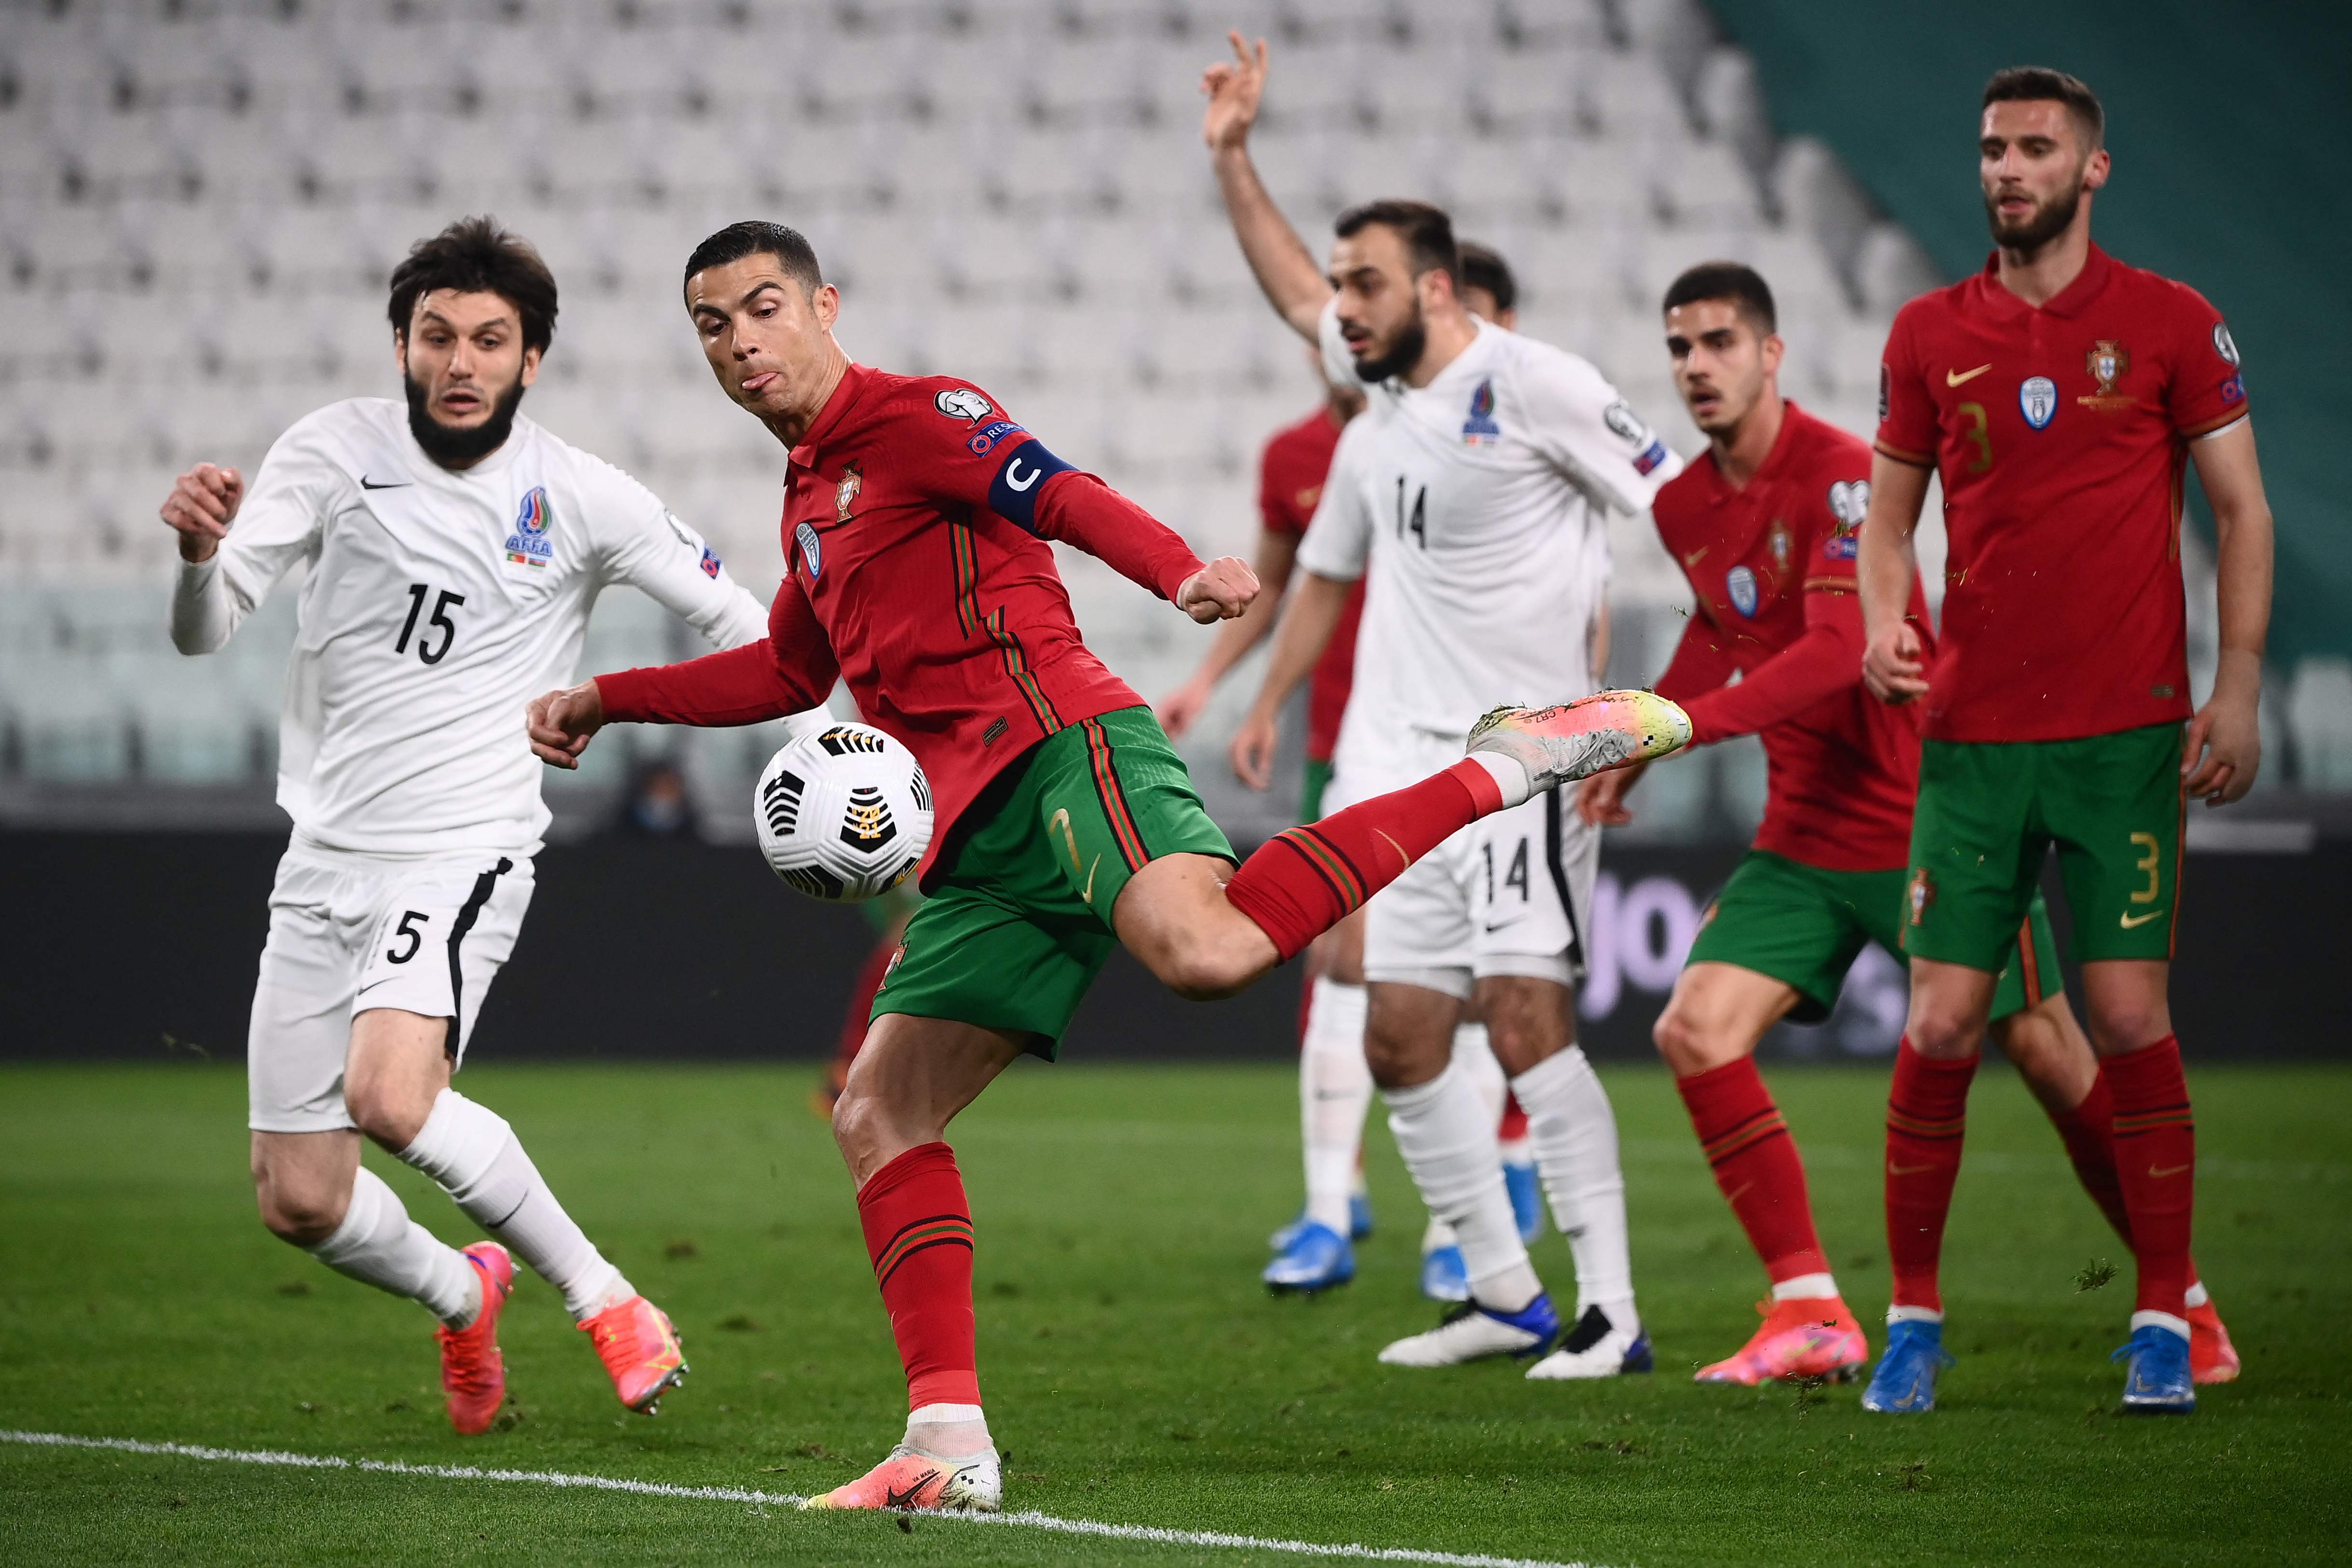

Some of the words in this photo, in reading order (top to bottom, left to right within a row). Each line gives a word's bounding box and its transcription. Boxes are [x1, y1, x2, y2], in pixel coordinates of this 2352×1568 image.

[1958, 402, 1992, 472] 3
[1006, 458, 1041, 492] C
[1397, 475, 1426, 550] 14
[506, 535, 552, 556] AFFA
[396, 584, 465, 665] 15
[1536, 711, 1556, 723] CR7
[858, 806, 881, 823] 20
[859, 822, 881, 839] 21
[1049, 808, 1081, 874] 7
[1483, 838, 1528, 904] 14
[2130, 832, 2159, 904] 3
[920, 1468, 936, 1478] MARIA
